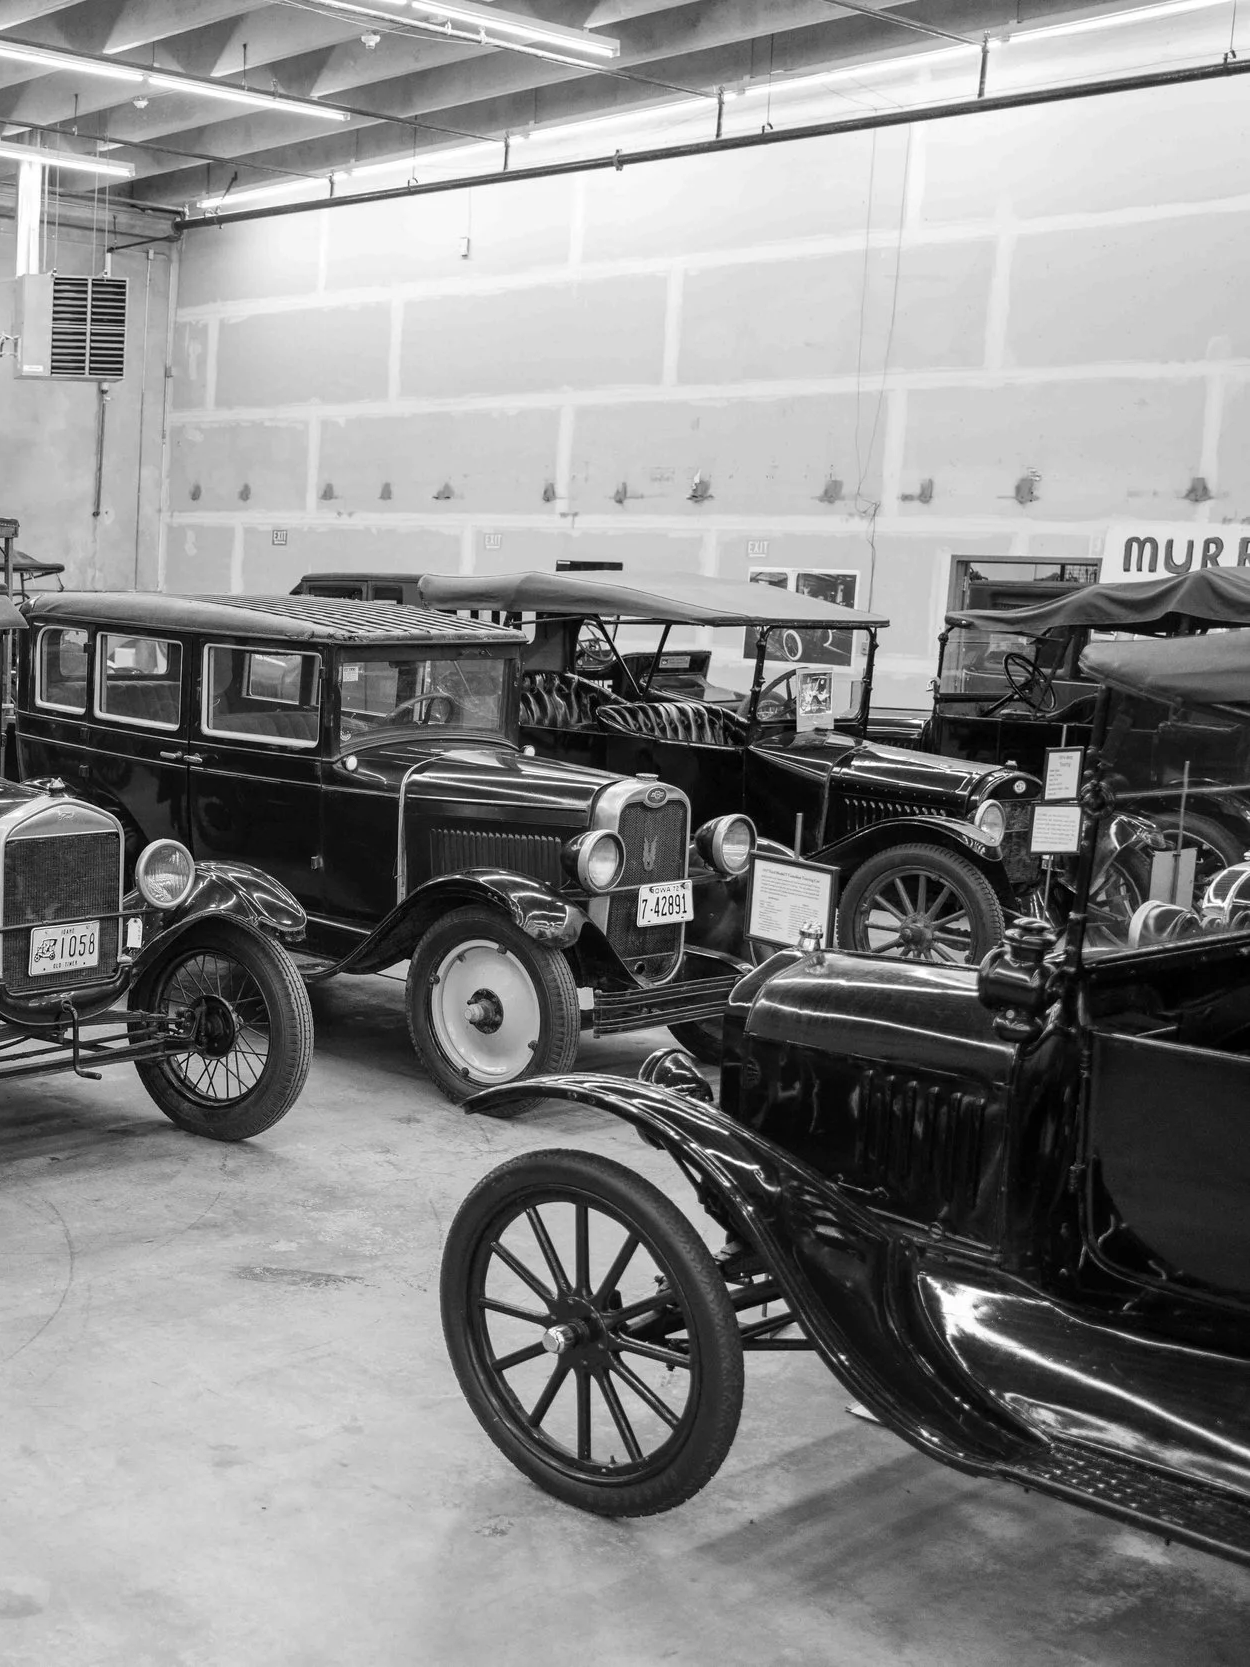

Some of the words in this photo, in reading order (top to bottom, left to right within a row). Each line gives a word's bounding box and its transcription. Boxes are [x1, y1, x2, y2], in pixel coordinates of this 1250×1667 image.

[273, 530, 287, 541] EXIT
[485, 534, 502, 545] EXIT
[748, 541, 769, 554] EXIT
[61, 927, 75, 935] IDAHO
[61, 932, 95, 959] 1058
